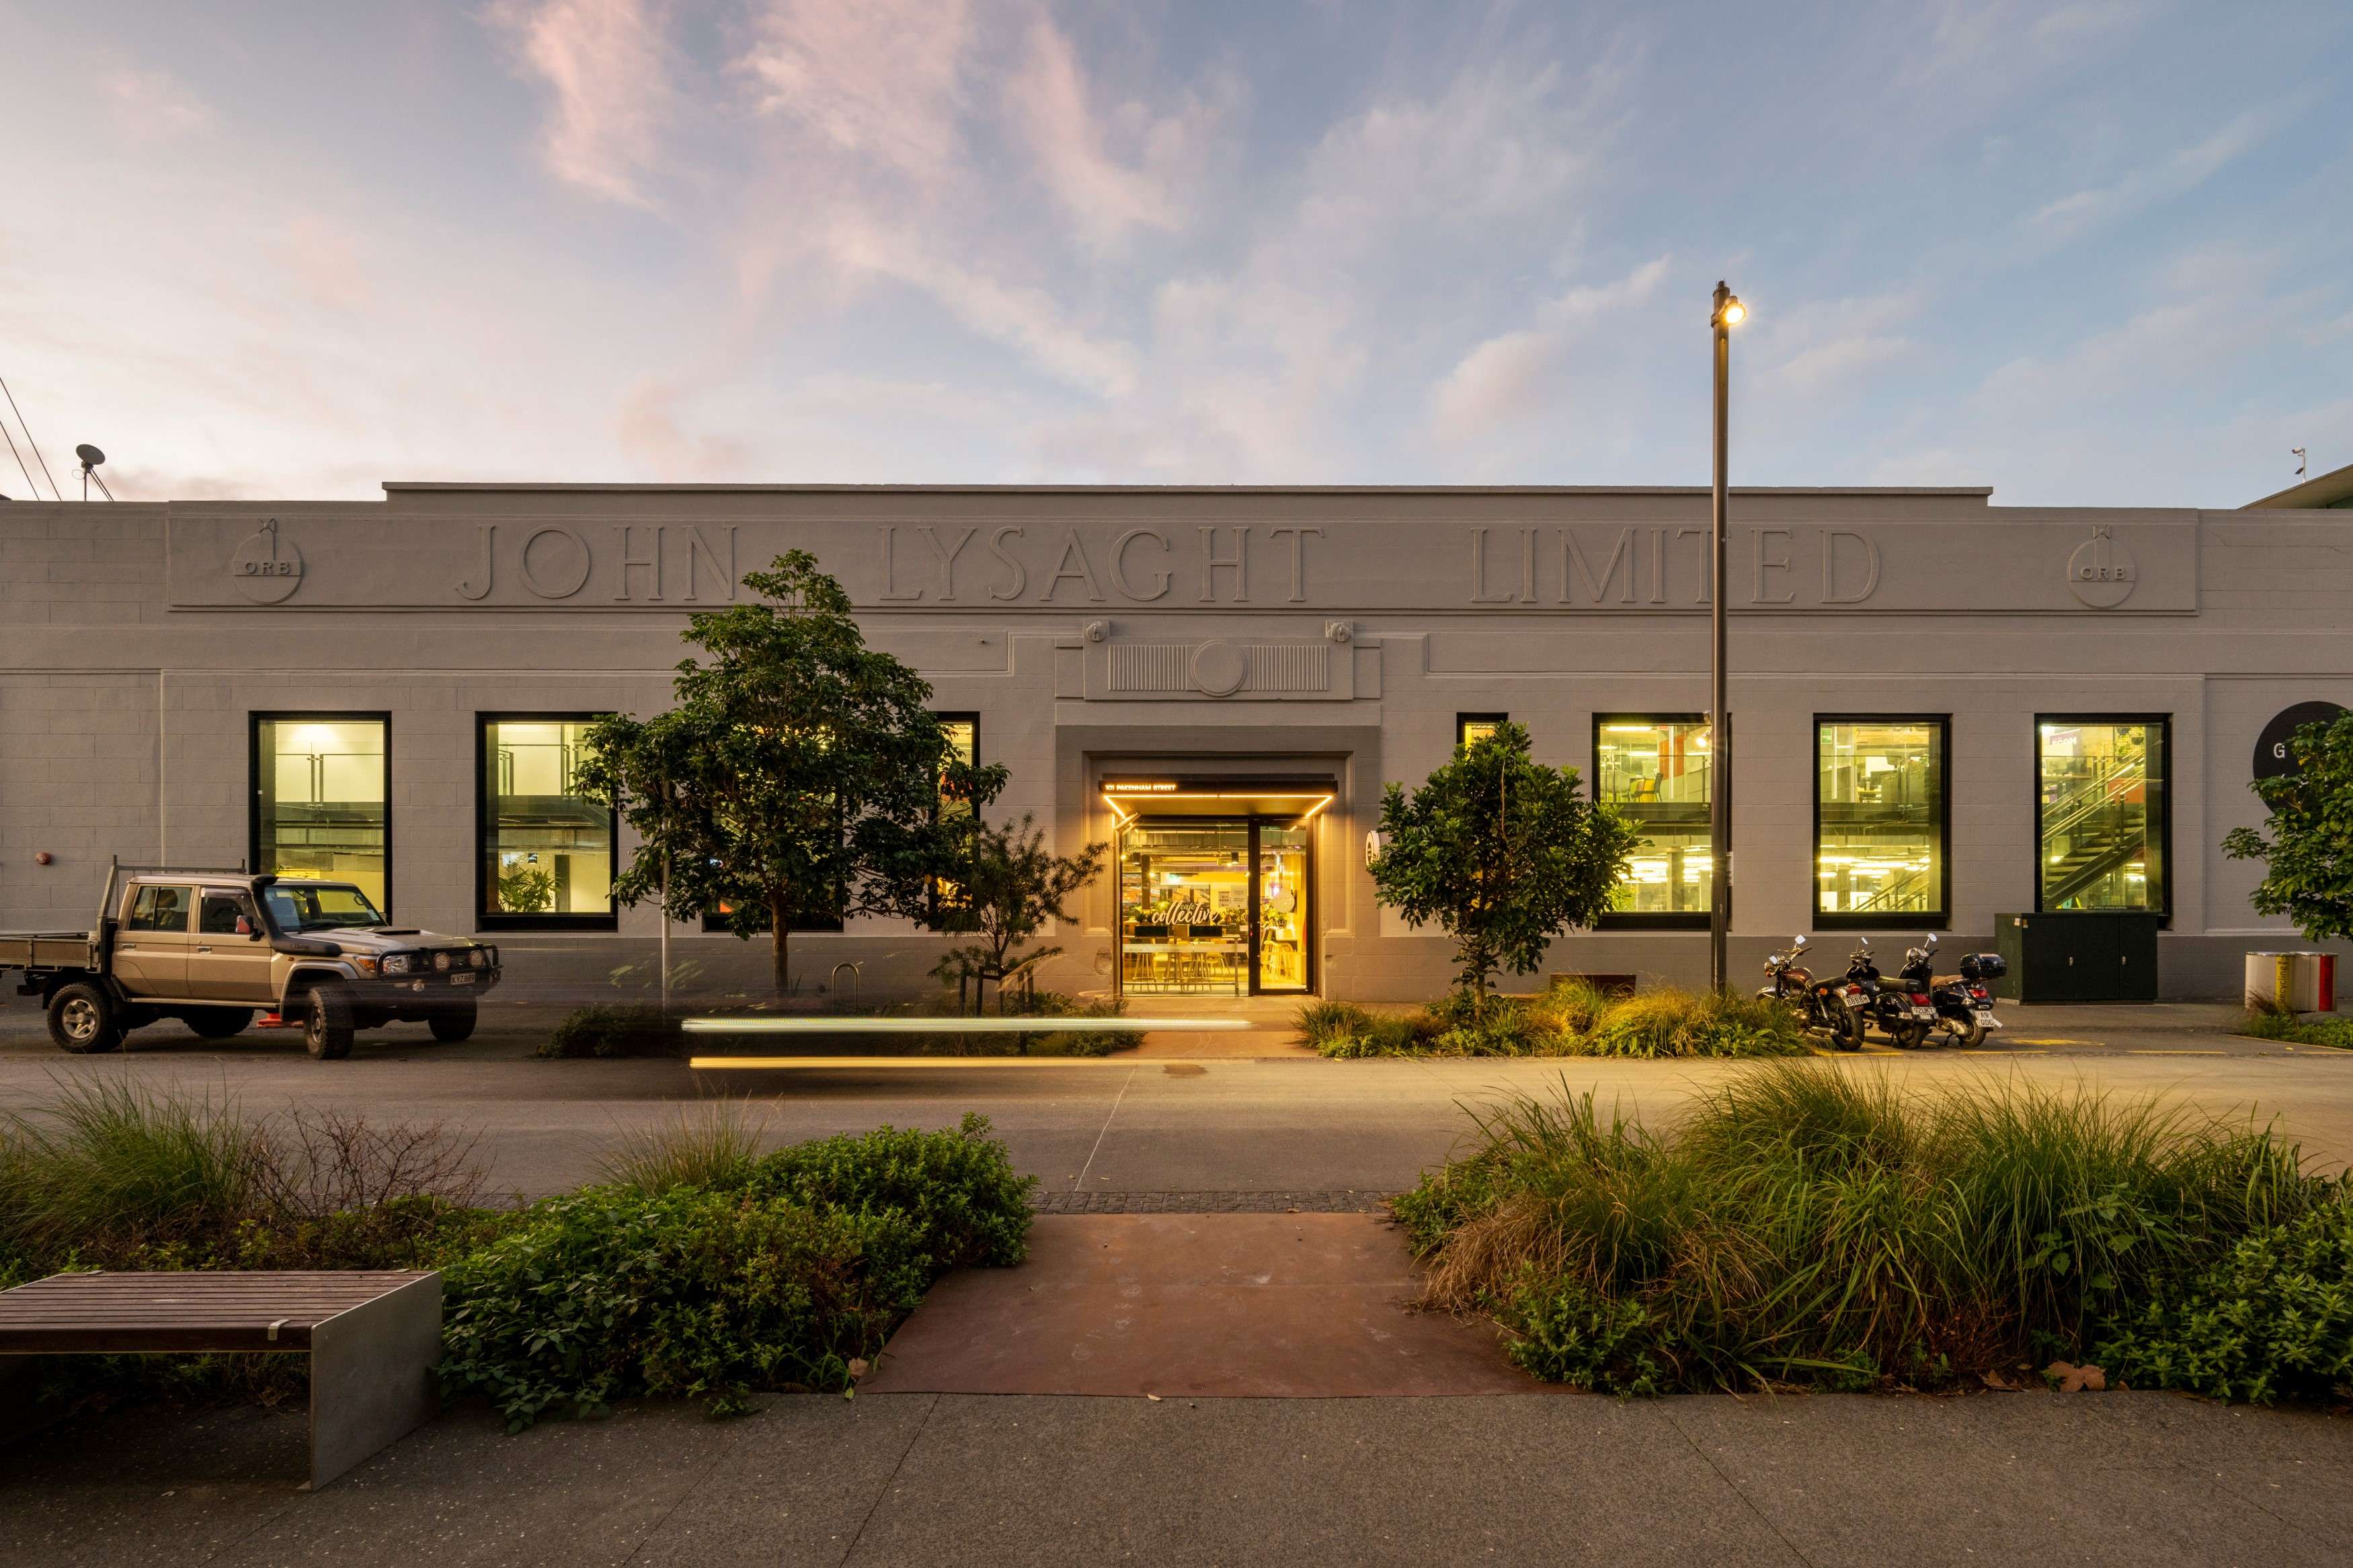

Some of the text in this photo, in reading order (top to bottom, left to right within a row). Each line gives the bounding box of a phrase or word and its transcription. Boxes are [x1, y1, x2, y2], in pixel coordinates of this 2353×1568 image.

[243, 561, 290, 575] ORB
[454, 524, 1881, 603] JOHN LYSAGHT LIMITED
[2079, 566, 2125, 581] ORB
[1152, 900, 1220, 925] collective
